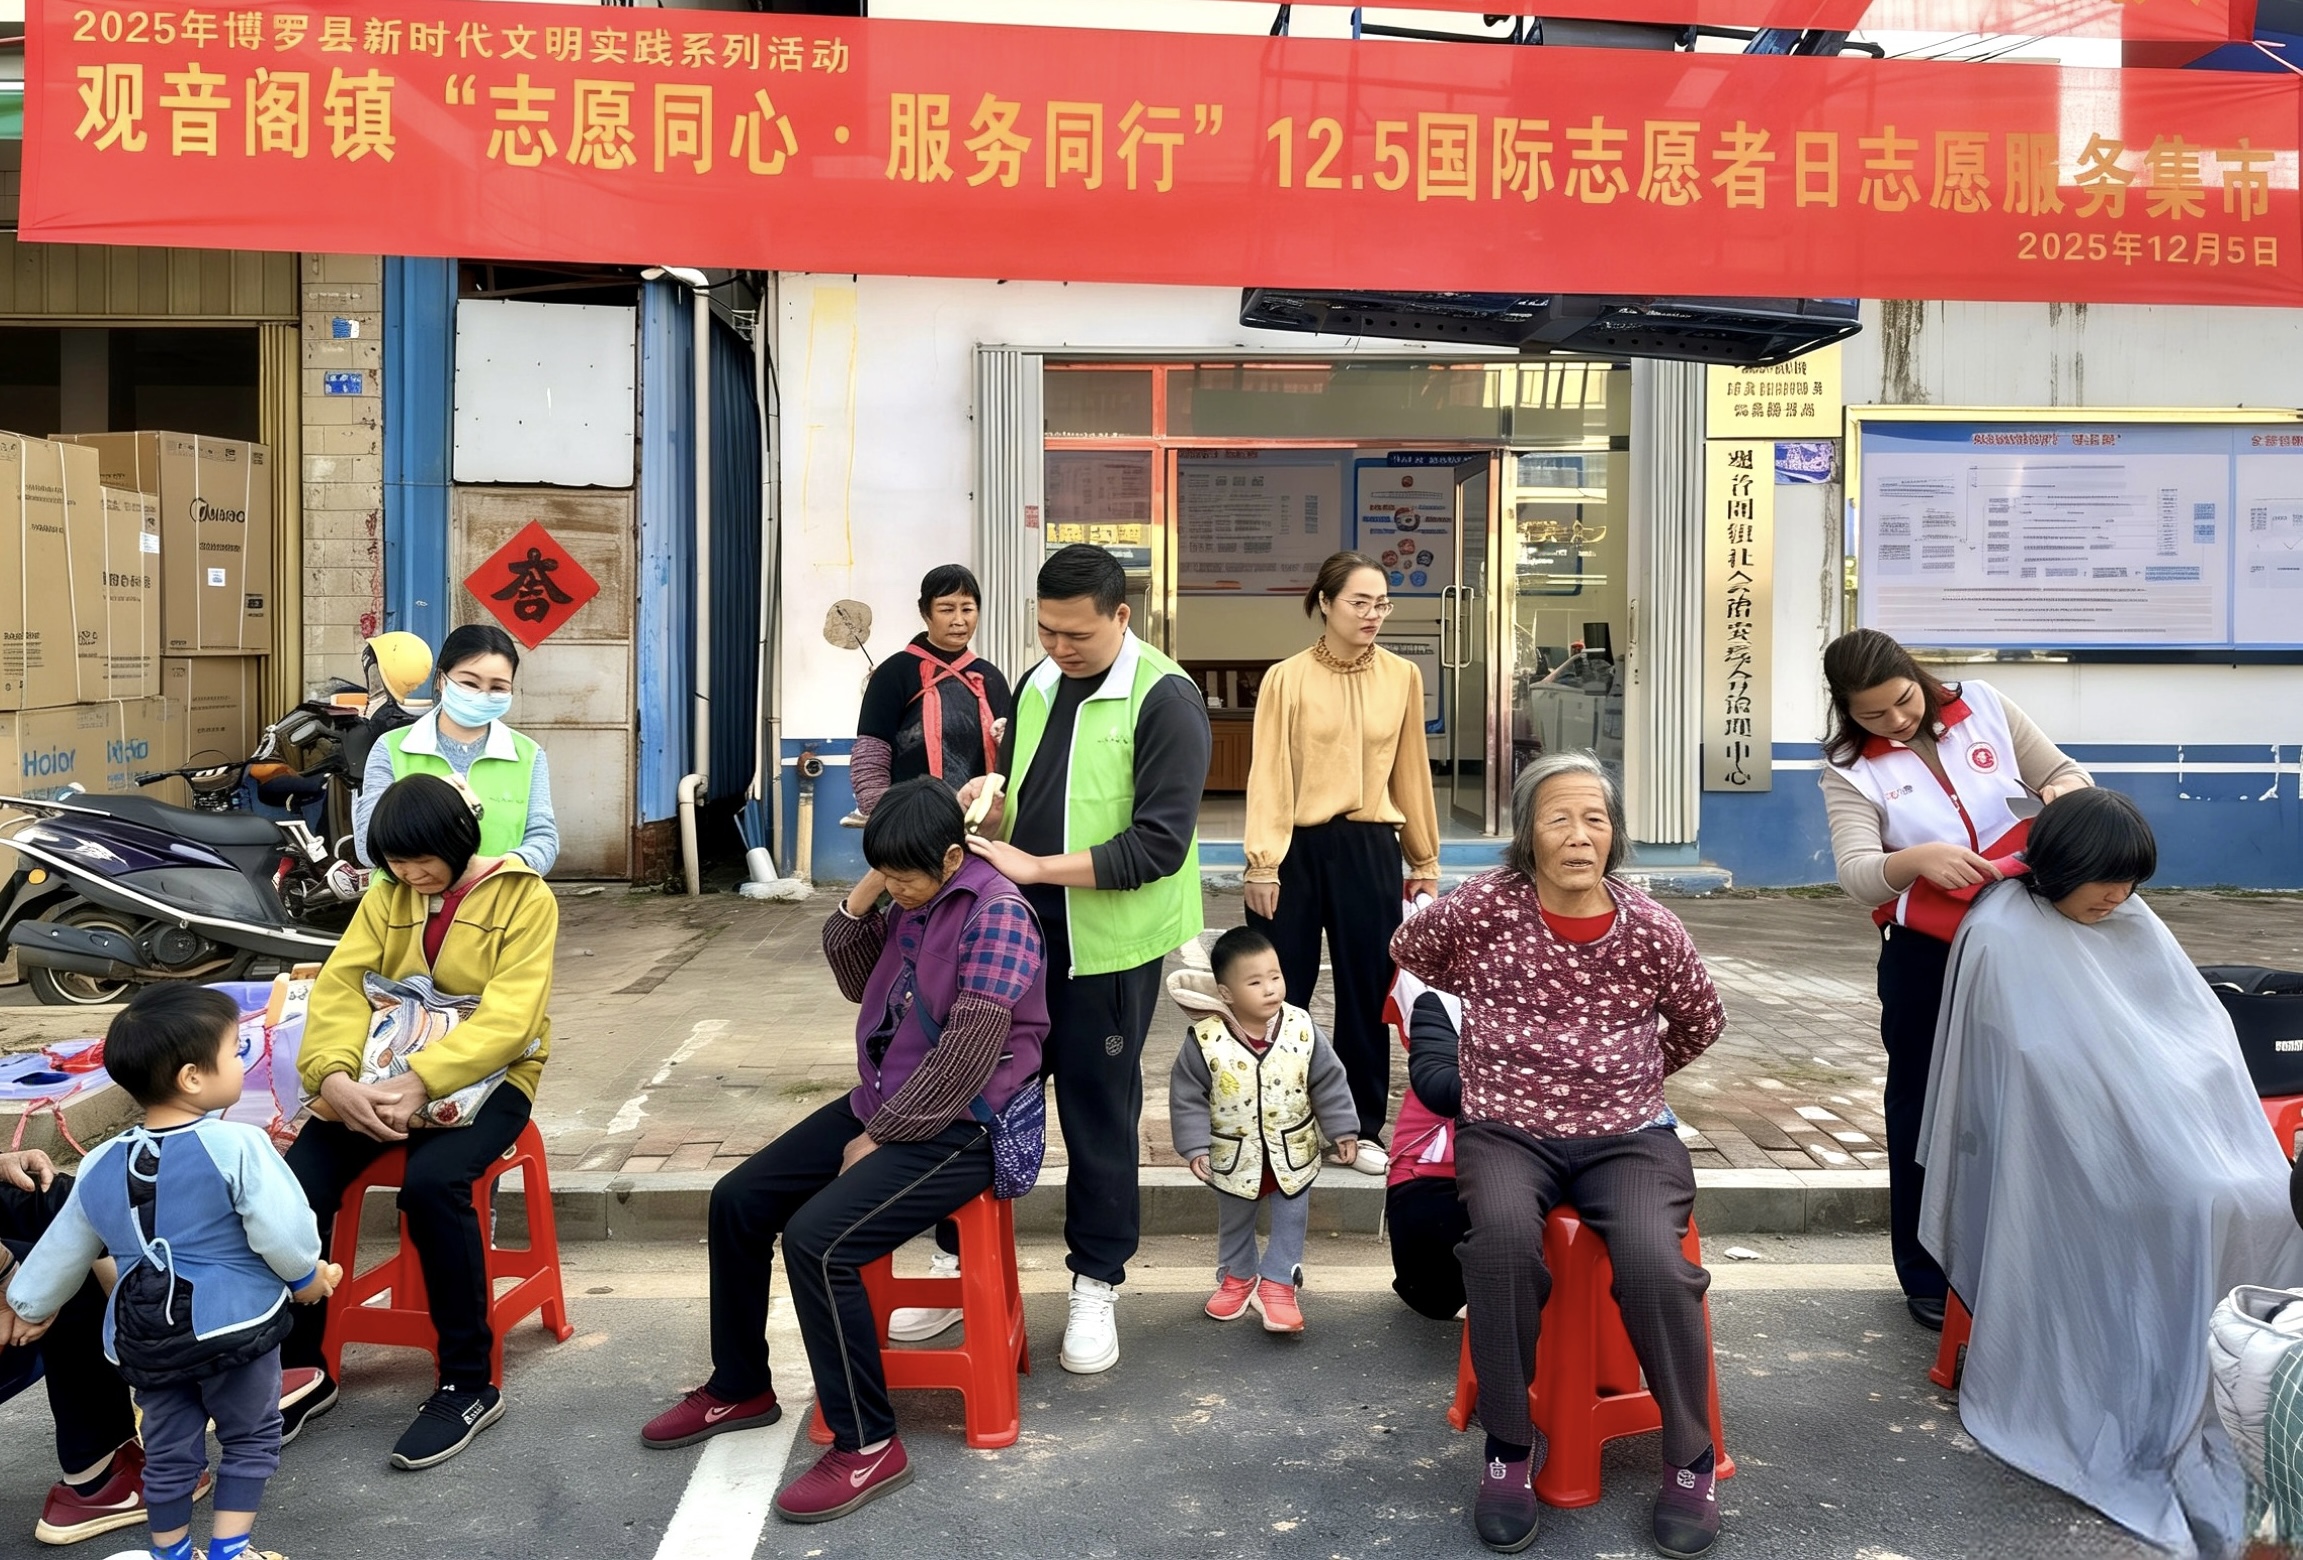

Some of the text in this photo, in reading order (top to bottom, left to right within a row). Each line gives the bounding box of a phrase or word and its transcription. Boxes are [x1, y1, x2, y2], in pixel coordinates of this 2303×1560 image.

[73, 9, 850, 76] 2025年博罗县新时代文明实践系列活动
[74, 62, 397, 163] 观音阁镇
[1267, 111, 2275, 222] 12.5国际志愿者日志愿服务集市
[2017, 230, 2278, 268] 2025年12月5日
